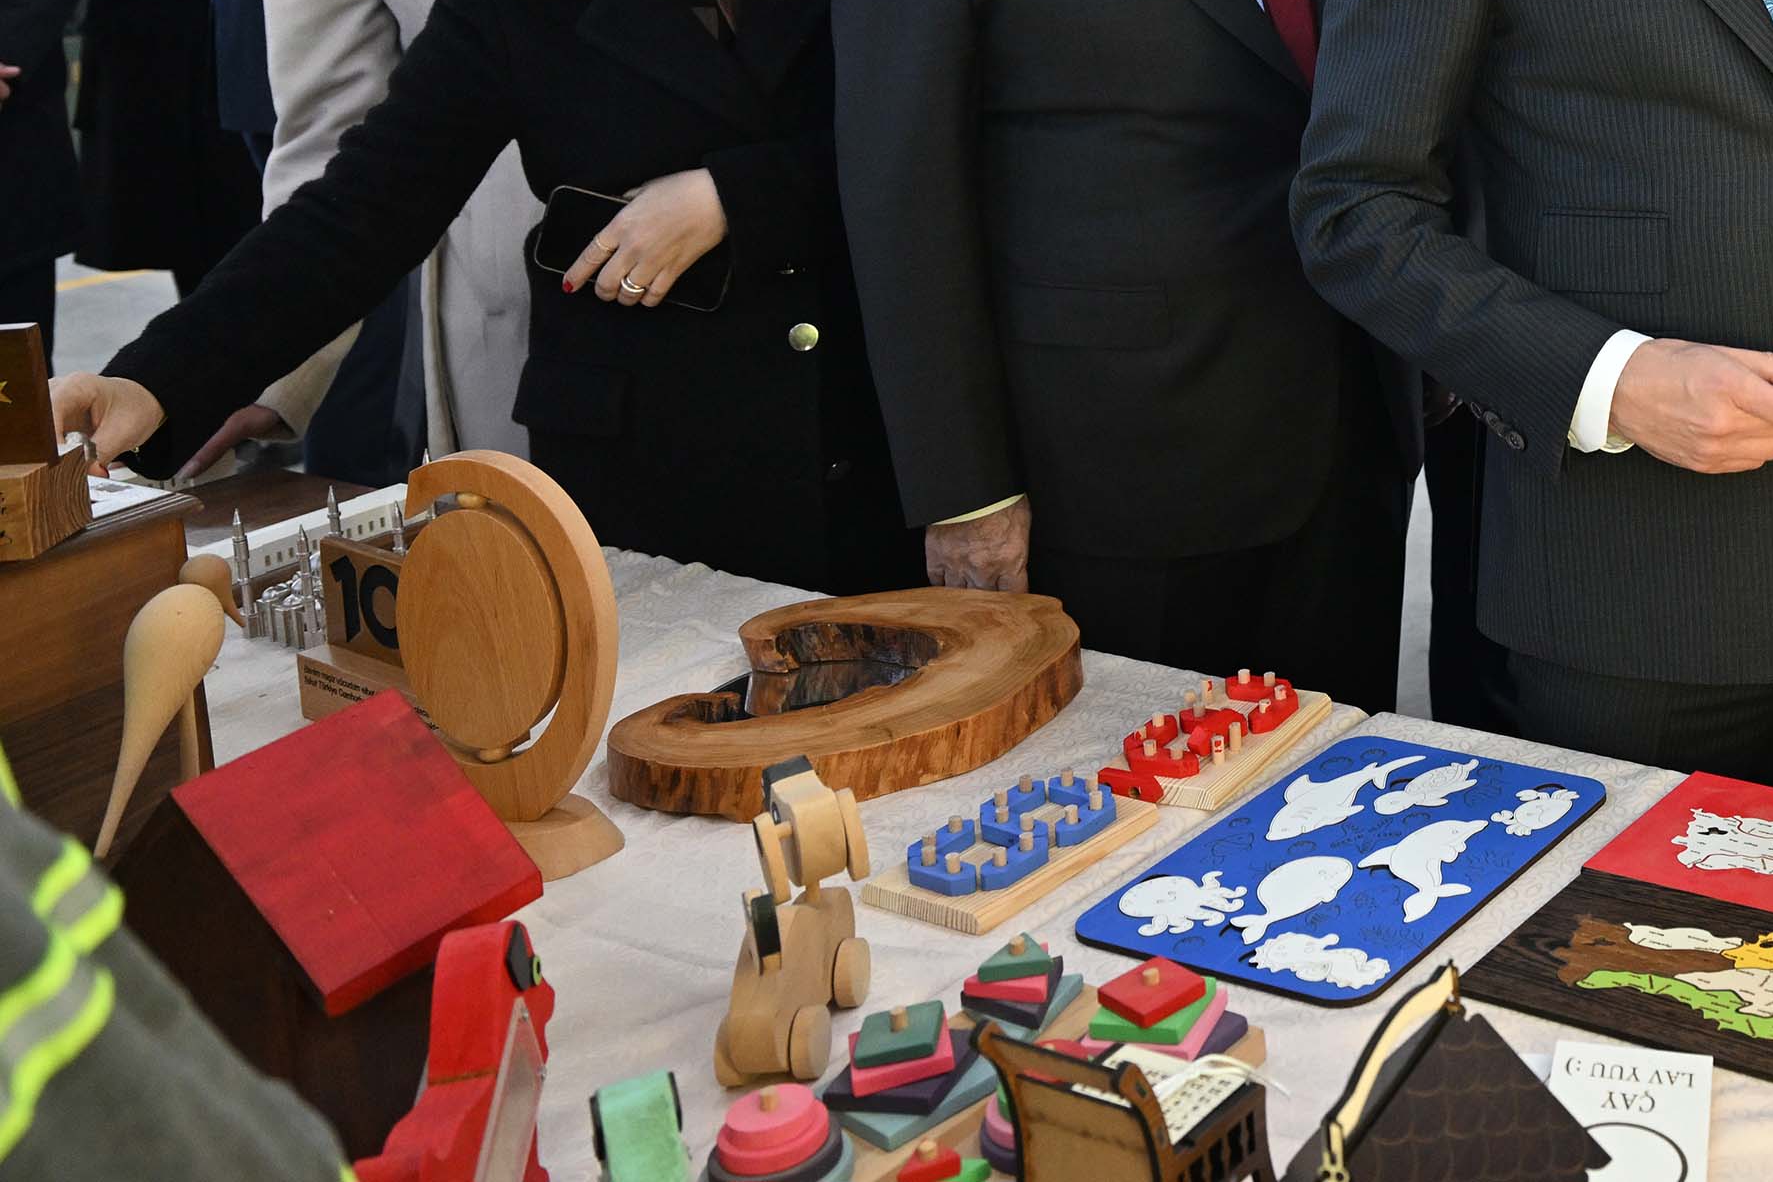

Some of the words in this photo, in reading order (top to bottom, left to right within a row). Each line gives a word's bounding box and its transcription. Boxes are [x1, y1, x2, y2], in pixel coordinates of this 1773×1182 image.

[1589, 1061, 1640, 1083] YUU
[1648, 1069, 1695, 1088] LAV
[1601, 1090, 1656, 1114] ÇAY
